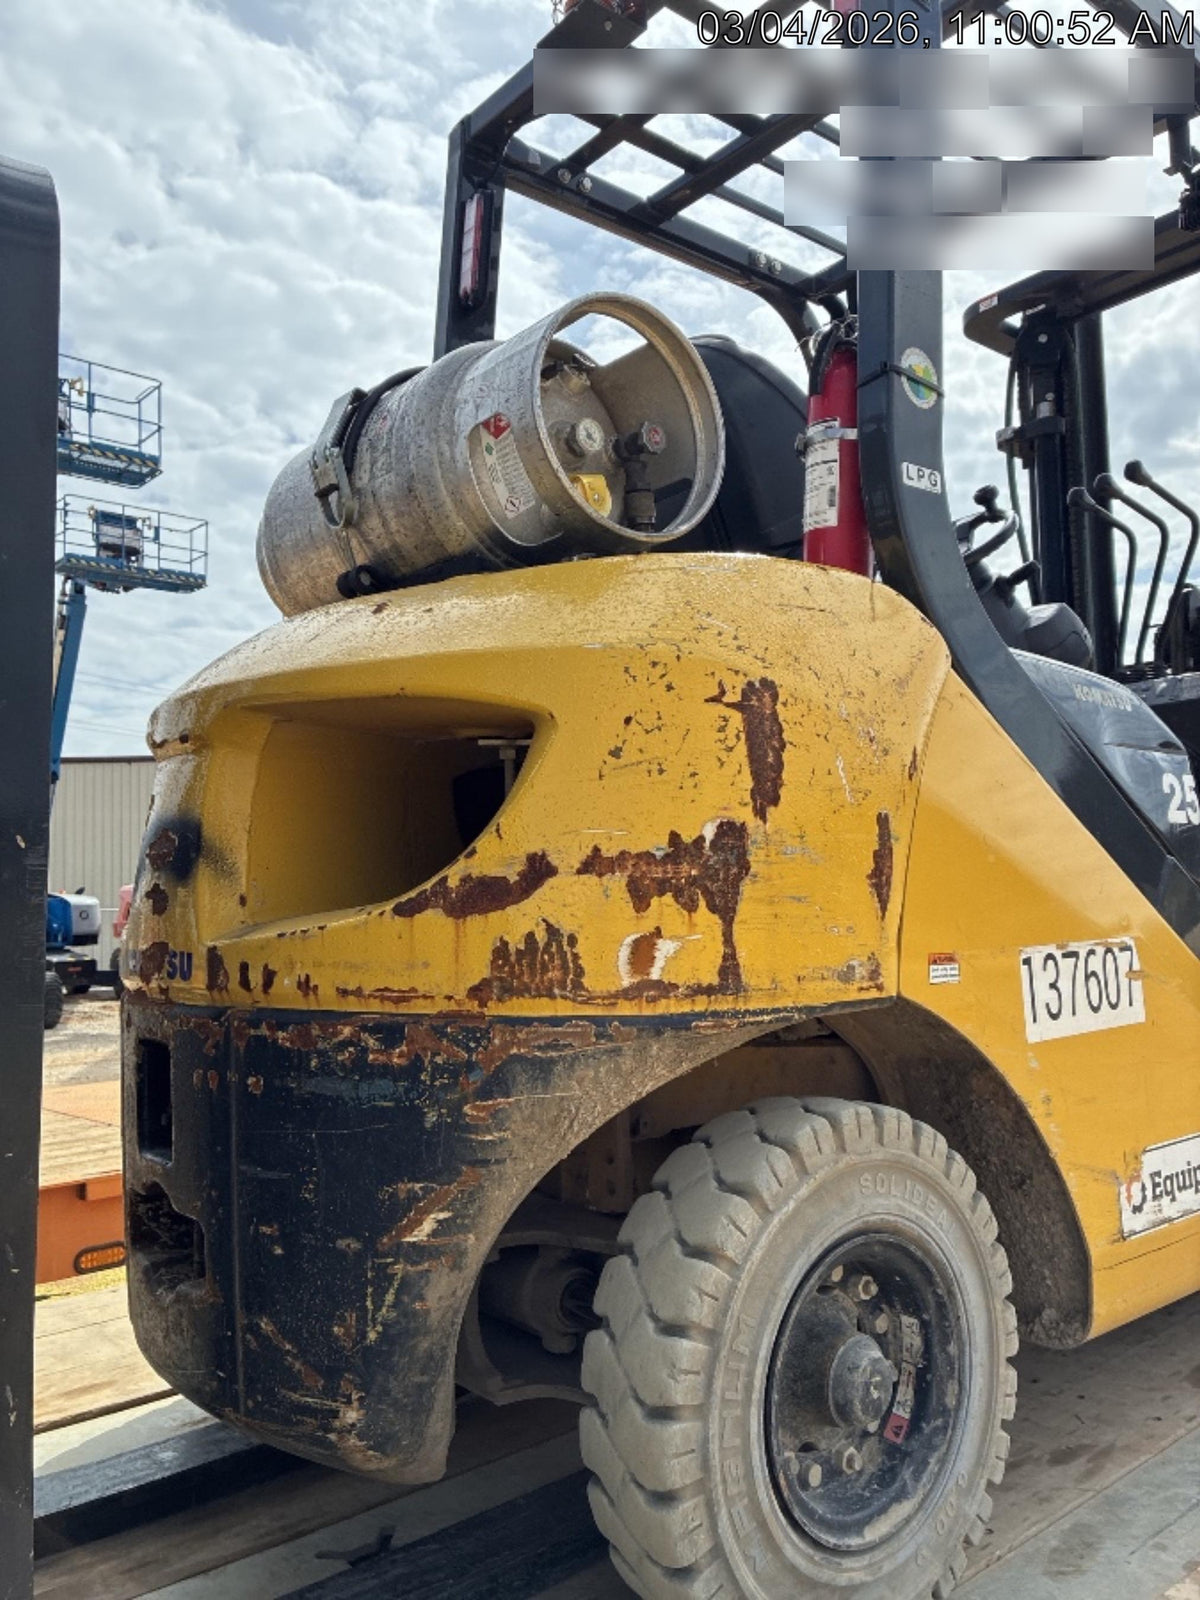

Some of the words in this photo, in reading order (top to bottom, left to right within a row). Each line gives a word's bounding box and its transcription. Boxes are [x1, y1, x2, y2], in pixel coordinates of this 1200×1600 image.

[906, 464, 938, 487] LPG
[1162, 772, 1200, 825] 25
[1021, 945, 1135, 1025] 137607
